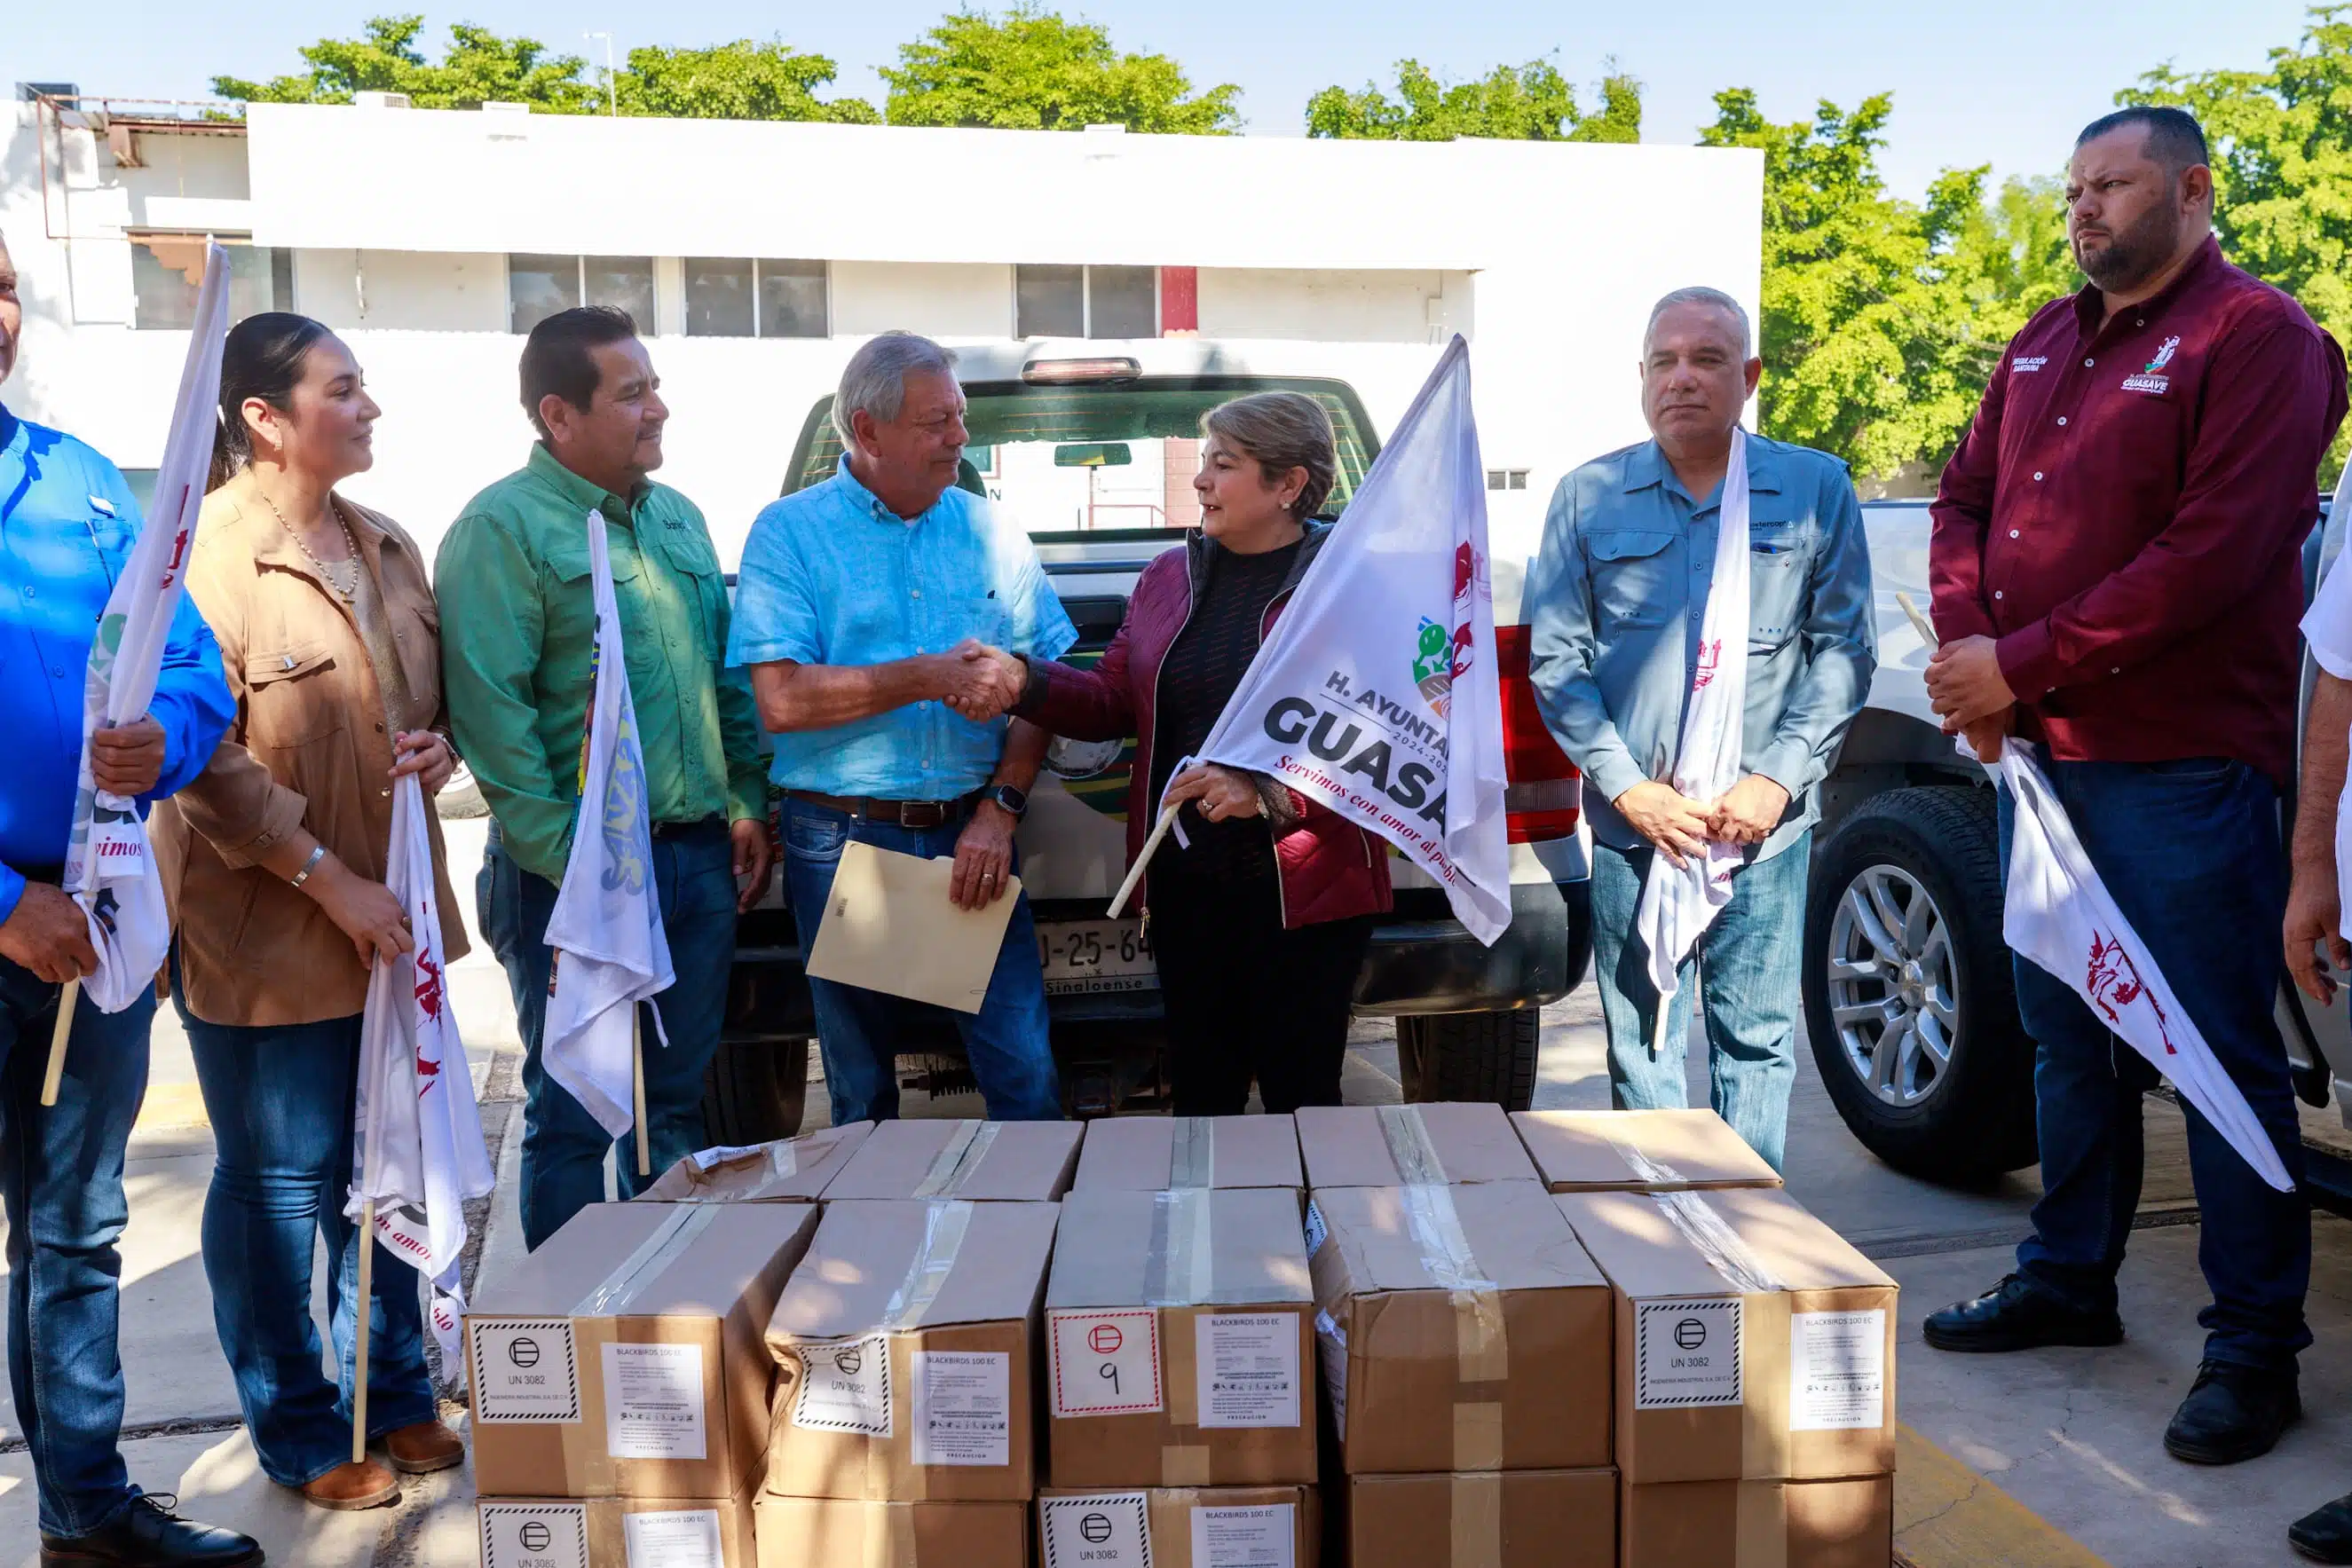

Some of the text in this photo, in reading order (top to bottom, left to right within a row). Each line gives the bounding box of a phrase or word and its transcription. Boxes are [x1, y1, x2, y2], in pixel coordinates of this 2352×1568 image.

[2122, 379, 2168, 390] GUASAVE
[1325, 671, 1449, 760] H. AYUNTA
[1275, 754, 1349, 799] Servimos
[1350, 794, 1379, 816] con
[1380, 811, 1423, 842] amor
[1420, 840, 1436, 859] al
[1046, 979, 1143, 994] Sinaloense
[1671, 1357, 1709, 1367] UN 3082
[508, 1375, 546, 1385] UN 3082
[1100, 1362, 1119, 1395] 9
[831, 1381, 865, 1394] UN 3082
[1205, 1510, 1248, 1519] BLACKBIRDS
[1251, 1509, 1264, 1518] 100
[639, 1517, 681, 1525] BLACKBIRDS
[1079, 1549, 1118, 1561] UN 3082
[518, 1558, 556, 1568] UN 3082
